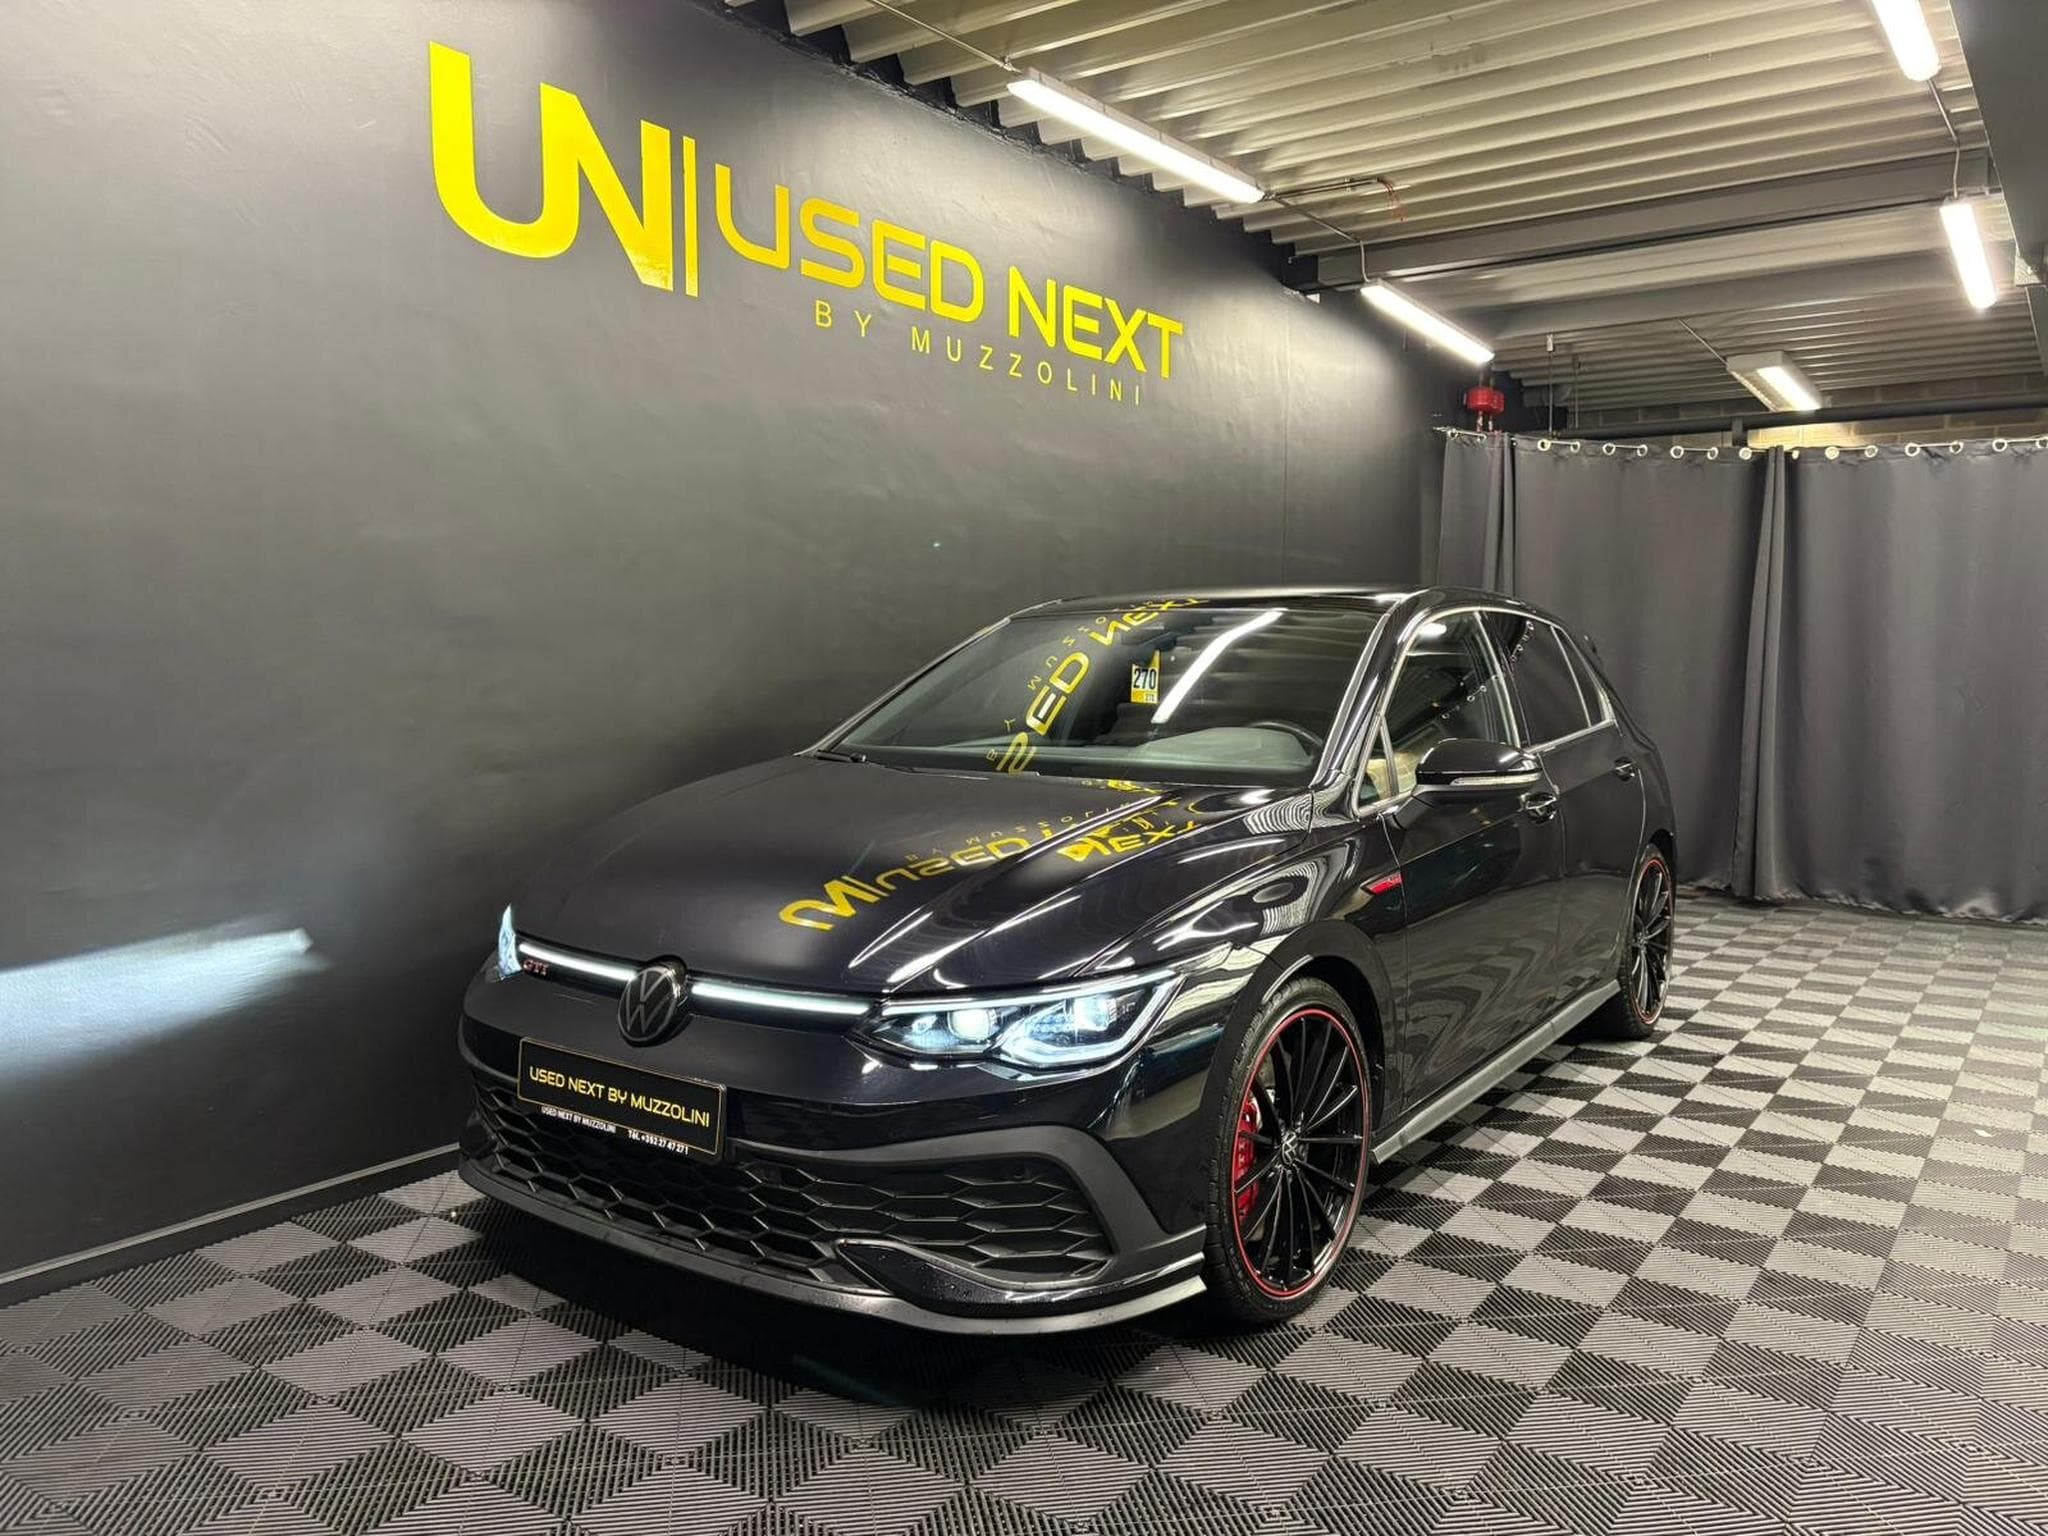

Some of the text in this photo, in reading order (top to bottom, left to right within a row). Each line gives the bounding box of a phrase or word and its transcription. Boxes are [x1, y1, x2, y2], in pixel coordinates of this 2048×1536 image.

[714, 164, 1184, 380] USED NEXT
[814, 300, 1142, 406] BY MUZZOLINI
[1133, 668, 1157, 690] 270
[529, 1066, 711, 1128] USED NEXT BY MUZZOLINI
